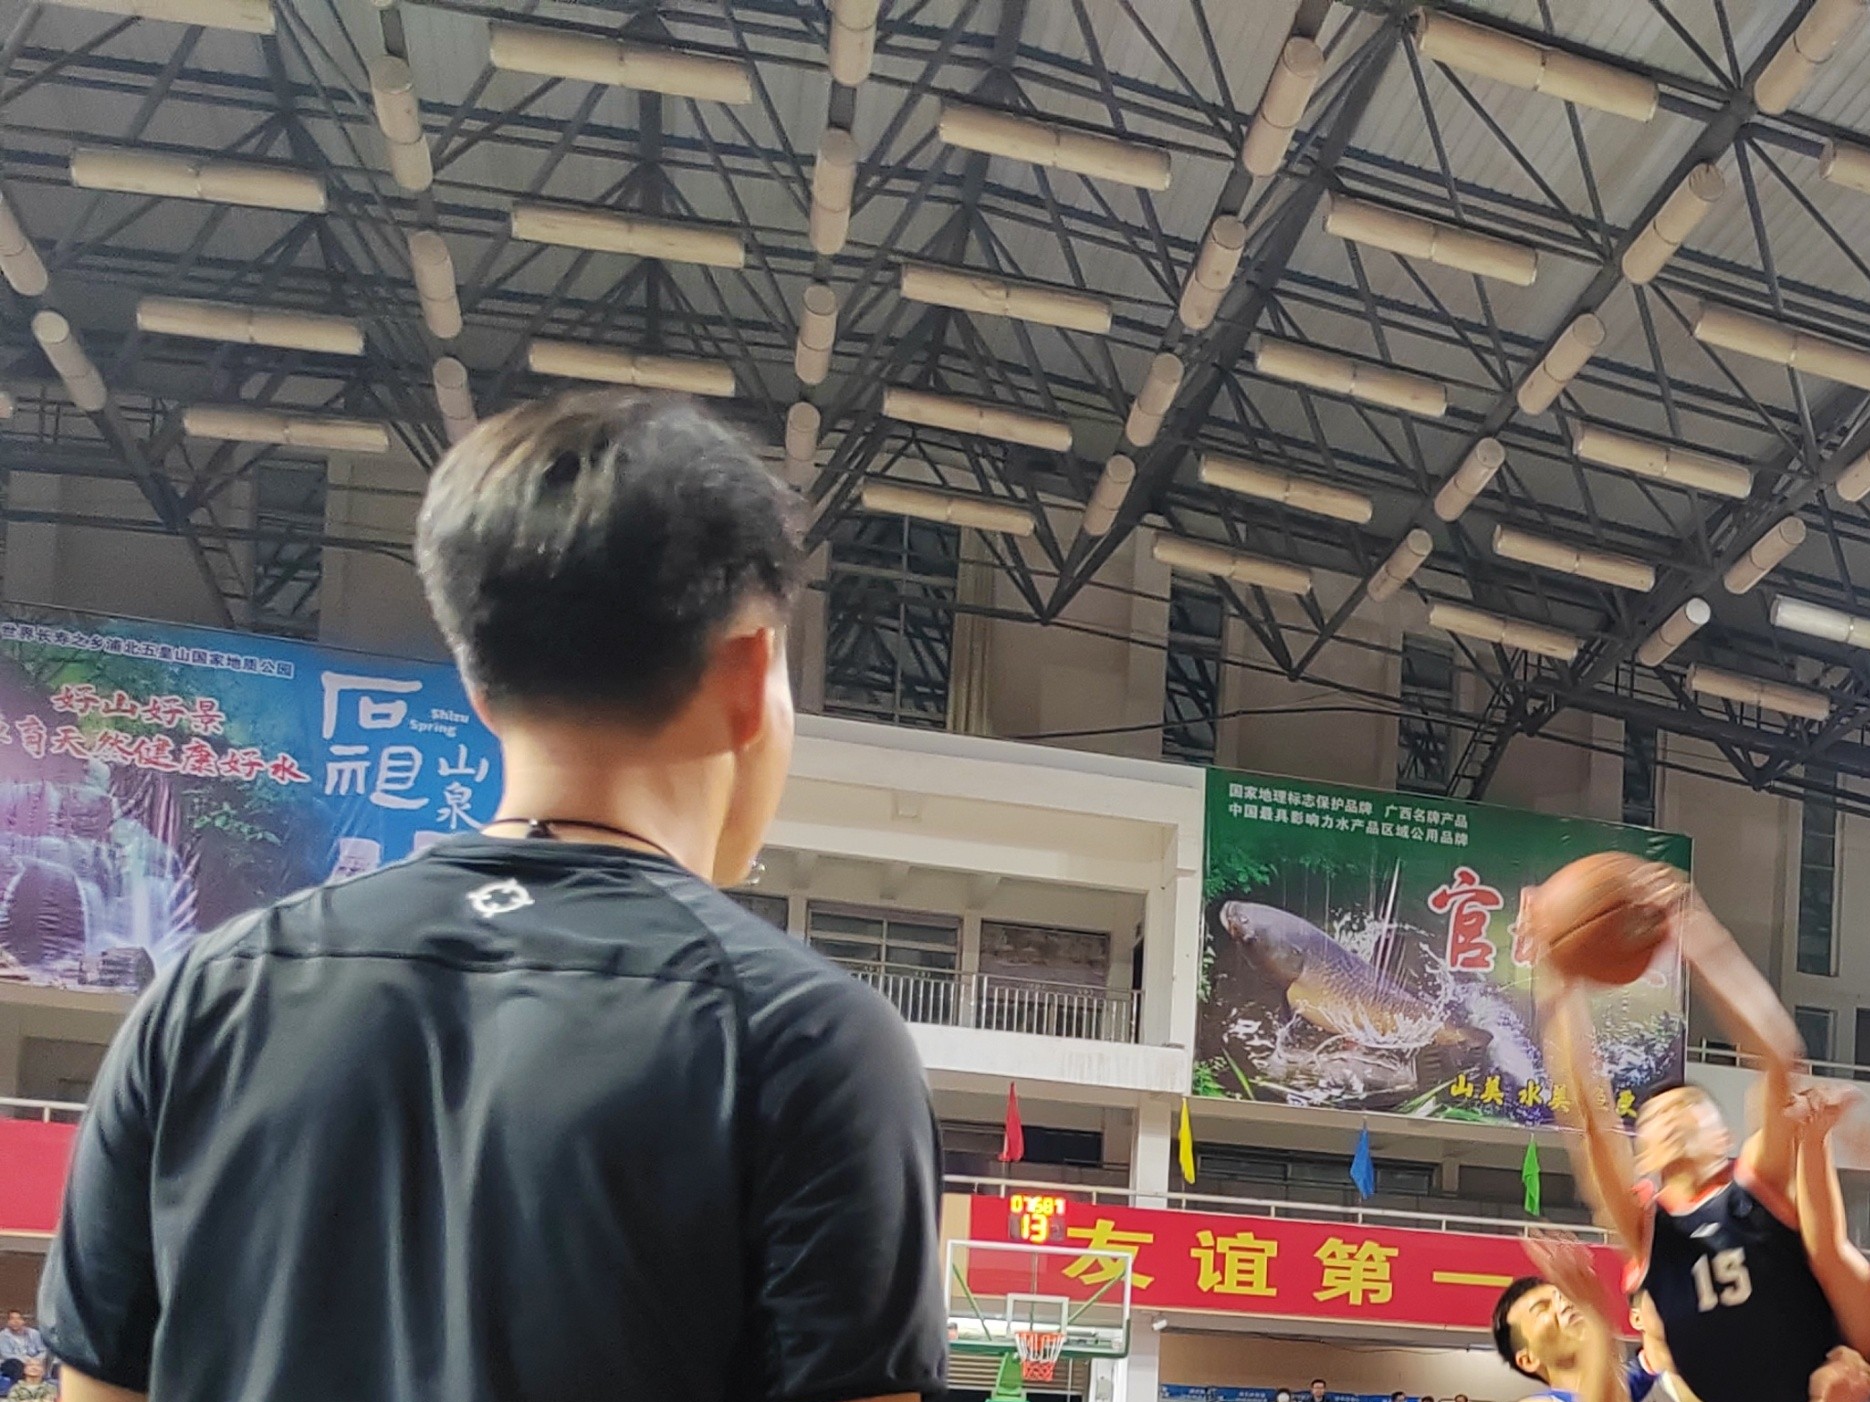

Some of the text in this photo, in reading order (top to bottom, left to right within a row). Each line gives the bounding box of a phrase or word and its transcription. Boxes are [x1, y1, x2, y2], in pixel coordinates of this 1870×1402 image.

[51, 684, 226, 736] 好山好景
[409, 719, 457, 738] Spring
[0, 714, 312, 785] 育天然健康好水
[1228, 802, 1469, 847] 中国最具影响力水产品区域公用品牌
[1384, 803, 1469, 829] 广西名牌产品
[1021, 1213, 1048, 1243] 13
[1690, 1246, 1753, 1313] 15
